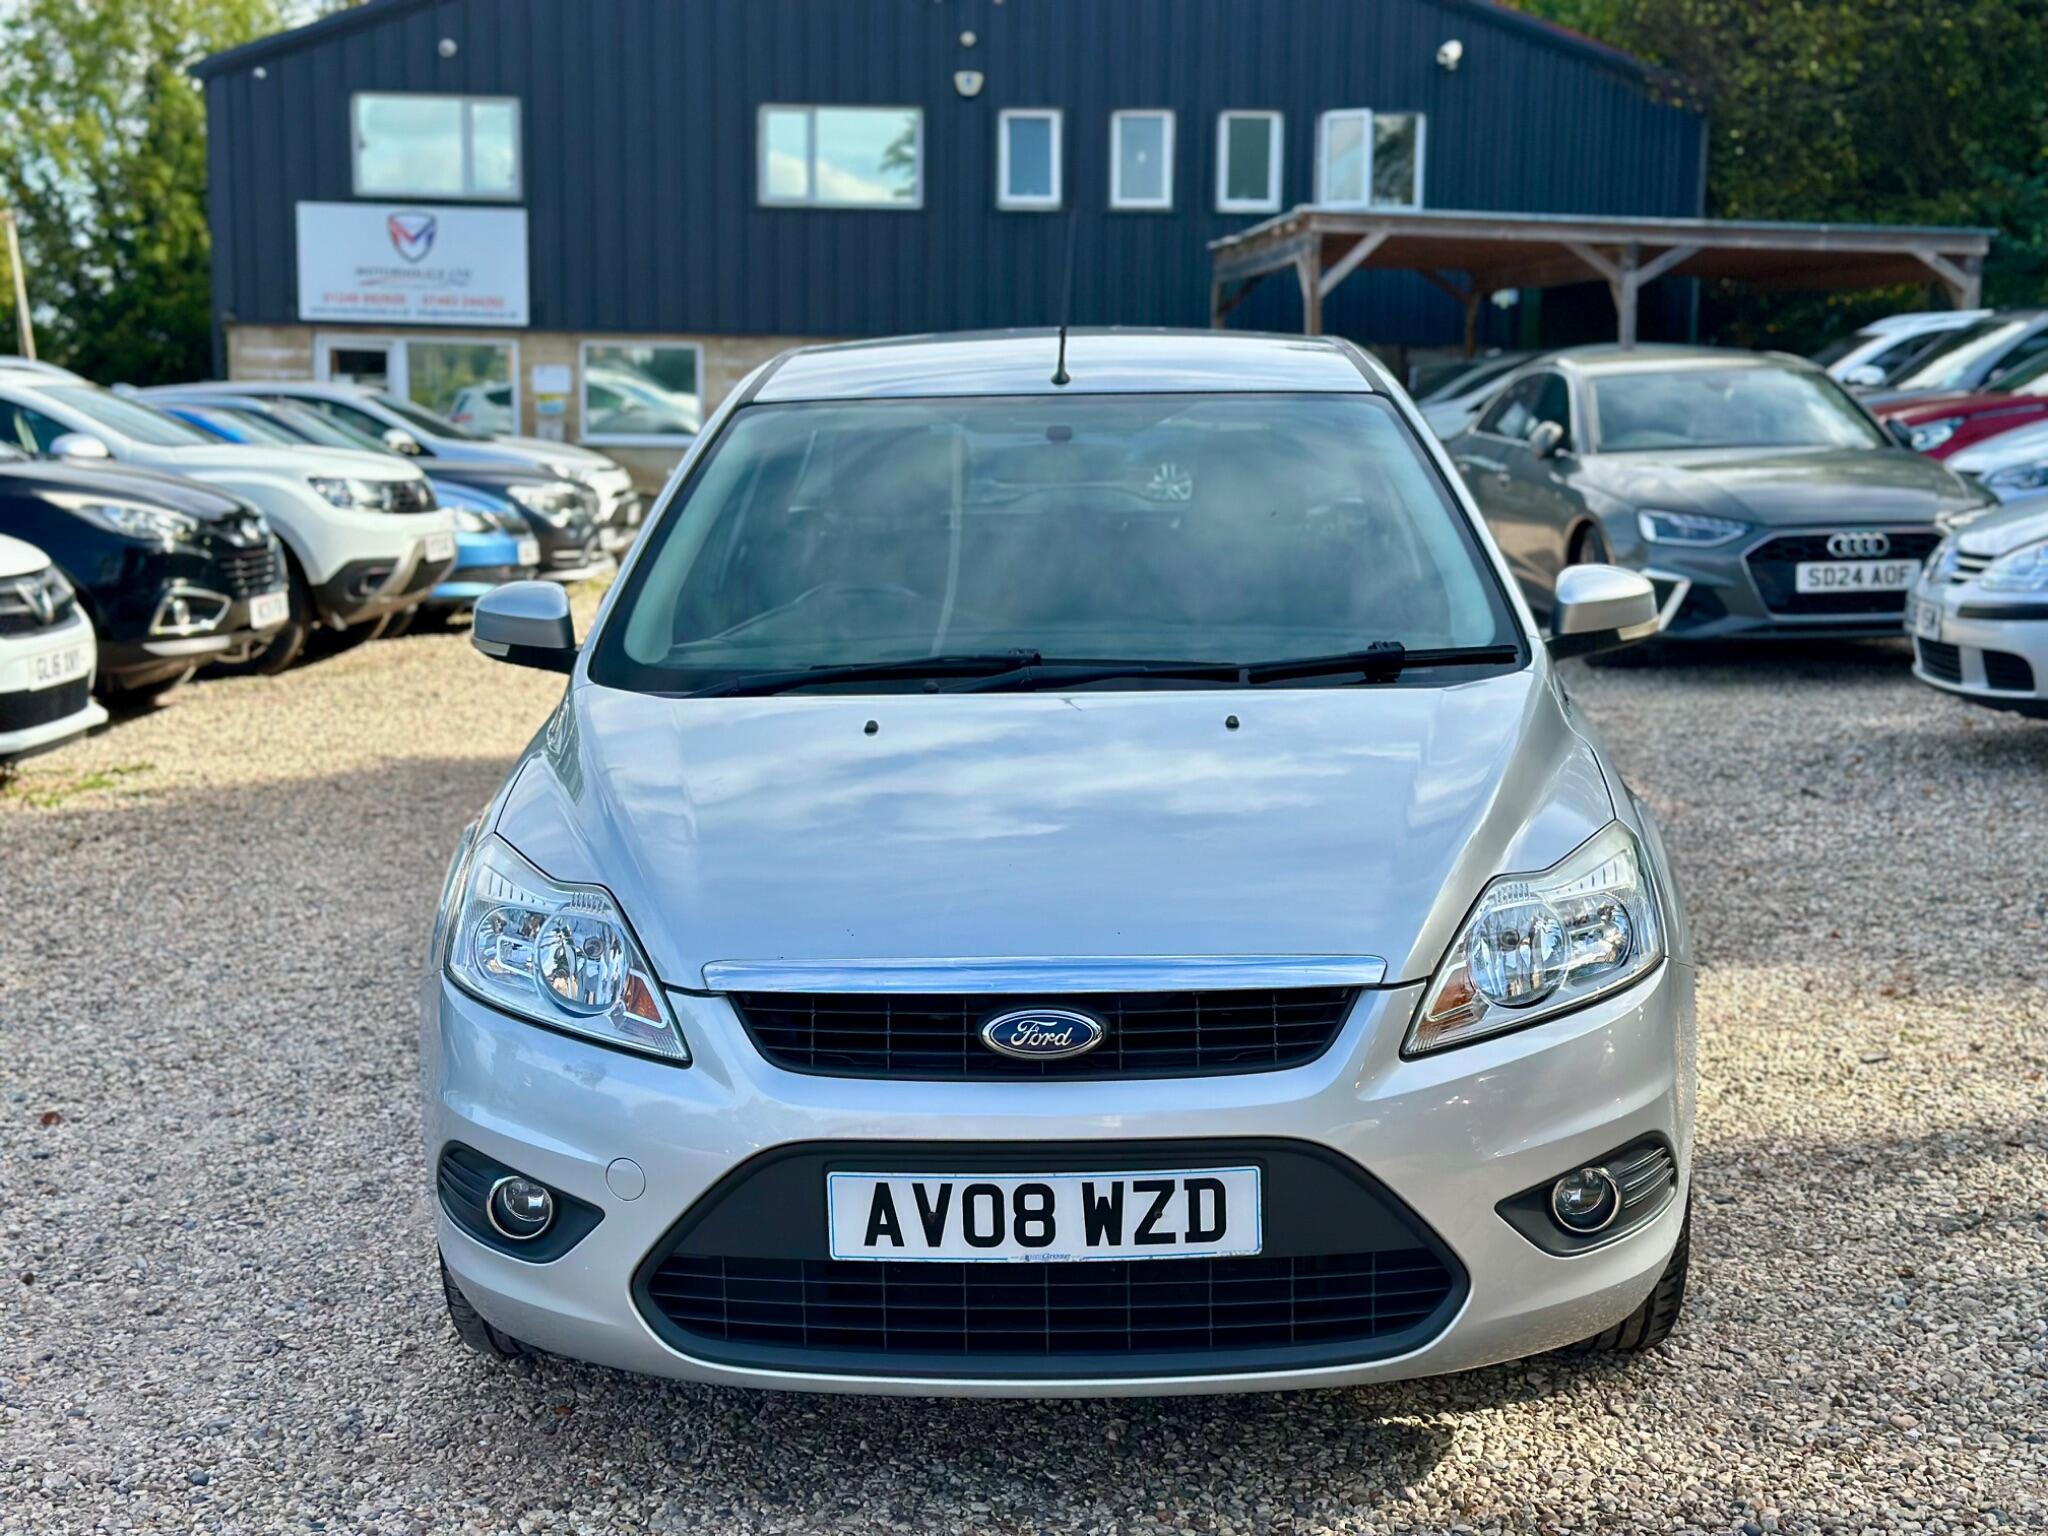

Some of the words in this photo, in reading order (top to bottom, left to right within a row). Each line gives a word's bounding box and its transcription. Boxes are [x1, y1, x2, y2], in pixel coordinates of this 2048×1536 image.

[1808, 567, 1862, 586] SD24
[1870, 566, 1911, 585] AOF
[1010, 1020, 1073, 1046] Ford
[864, 1181, 1056, 1248] AV08
[1082, 1177, 1227, 1247] WZD
